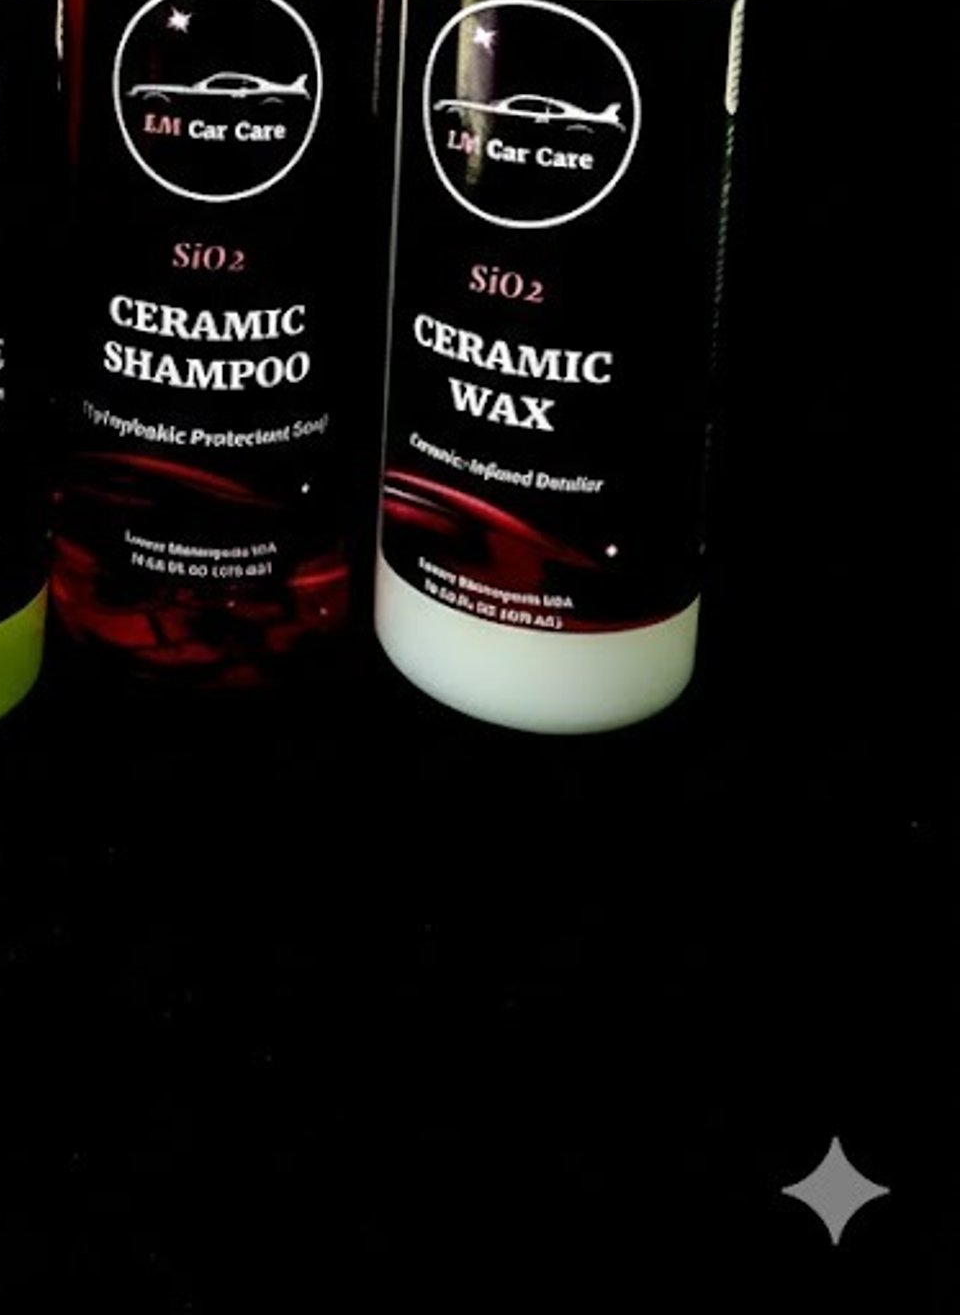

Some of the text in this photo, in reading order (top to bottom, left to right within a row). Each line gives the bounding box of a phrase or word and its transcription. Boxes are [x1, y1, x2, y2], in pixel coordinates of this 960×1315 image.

[143, 113, 287, 142] LM Car Care
[447, 129, 594, 170] LM Car Care
[108, 294, 306, 341] CERAMIC
[103, 338, 311, 391] SHAMPOO
[413, 313, 613, 384] CERAMIC
[448, 375, 559, 432] WAX
